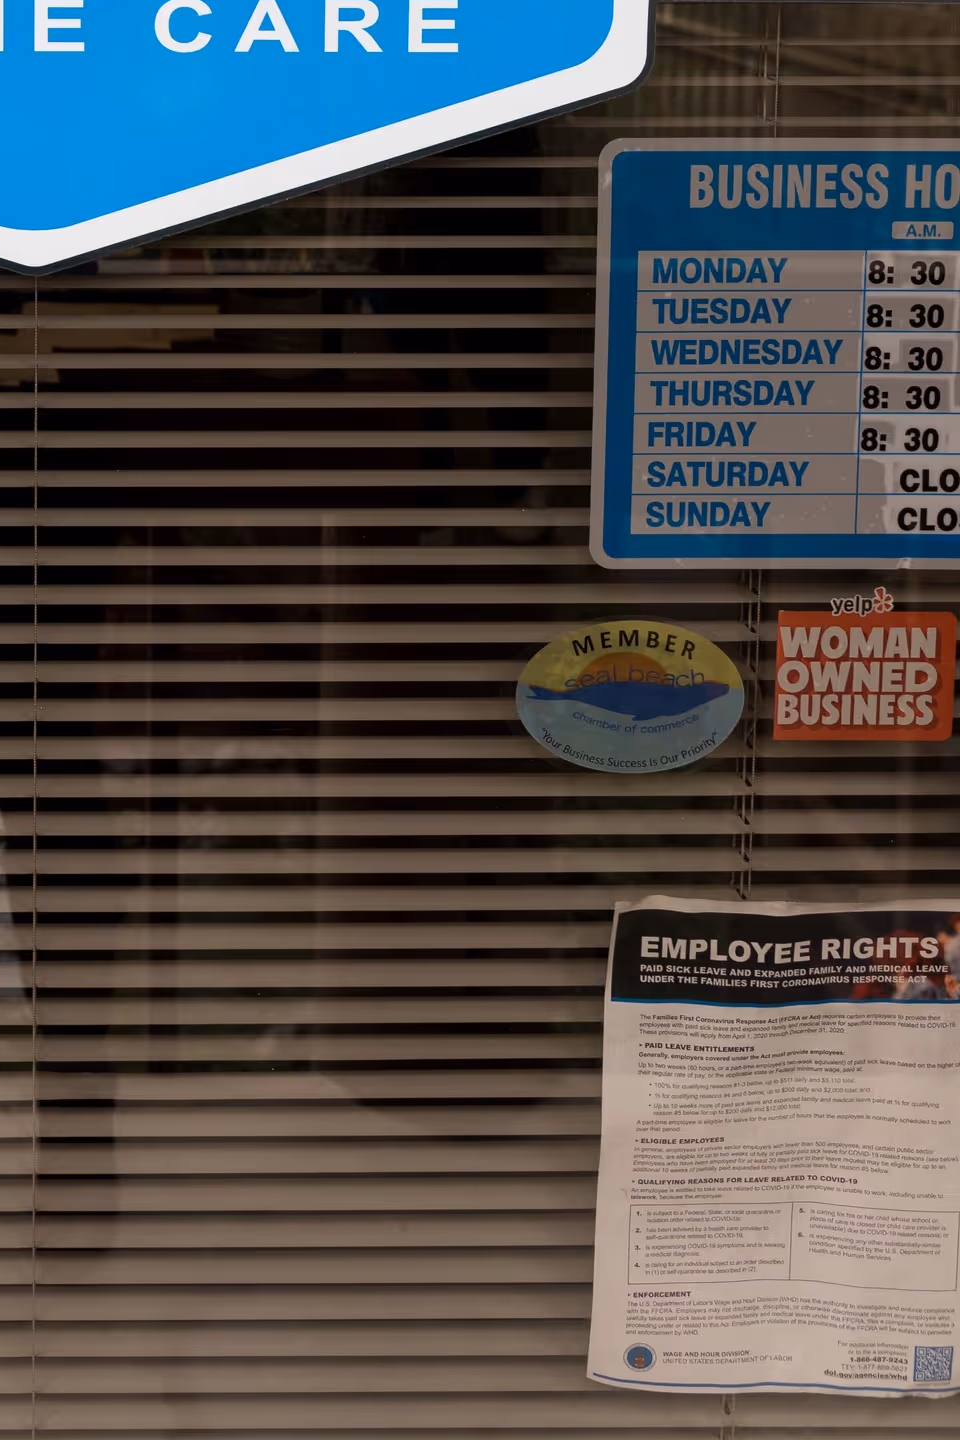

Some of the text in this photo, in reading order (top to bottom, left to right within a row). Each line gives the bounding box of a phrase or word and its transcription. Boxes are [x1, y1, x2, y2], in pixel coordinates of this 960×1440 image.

[689, 164, 960, 209] BUSINESS HO
[906, 225, 941, 237] A.M.
[652, 258, 945, 285] MONDAY 8: 30
[652, 298, 944, 328] TUESDAY 8: 30
[651, 339, 943, 370] WEDNESDAY 8: 30
[650, 380, 940, 409] THURSDAY 8: 30
[648, 421, 938, 451] FRIDAY 8: 30
[646, 461, 809, 487] SATURDAY
[646, 501, 960, 531] SUNDAY CLO
[832, 596, 872, 615] yelp
[572, 630, 696, 660] MEMBER
[780, 626, 937, 659] WOMAN
[565, 664, 704, 688] seal beach
[777, 661, 937, 693] OWNED
[573, 712, 621, 732] chamber
[625, 725, 637, 733] of
[777, 694, 933, 725] BUSINESS
[562, 745, 604, 765] Business
[608, 758, 646, 768] Success
[650, 758, 657, 766] Is
[660, 755, 679, 765] Our
[640, 936, 939, 964] EMPLOYEE RIGHTS
[640, 964, 663, 972] PAID
[666, 965, 690, 973] SICK
[694, 967, 727, 975] LEAVE
[754, 969, 806, 978] EXPANDED
[809, 966, 842, 975] FAMILY
[640, 975, 674, 983] UNDER
[678, 976, 698, 984] THE
[701, 977, 747, 987] FAMILIES
[750, 980, 779, 988] FIRST
[782, 976, 850, 987] CORONAVIRUS
[696, 1016, 734, 1024] Coronavirus
[820, 1175, 857, 1184] COVID-19
[843, 1250, 864, 1259] Human
